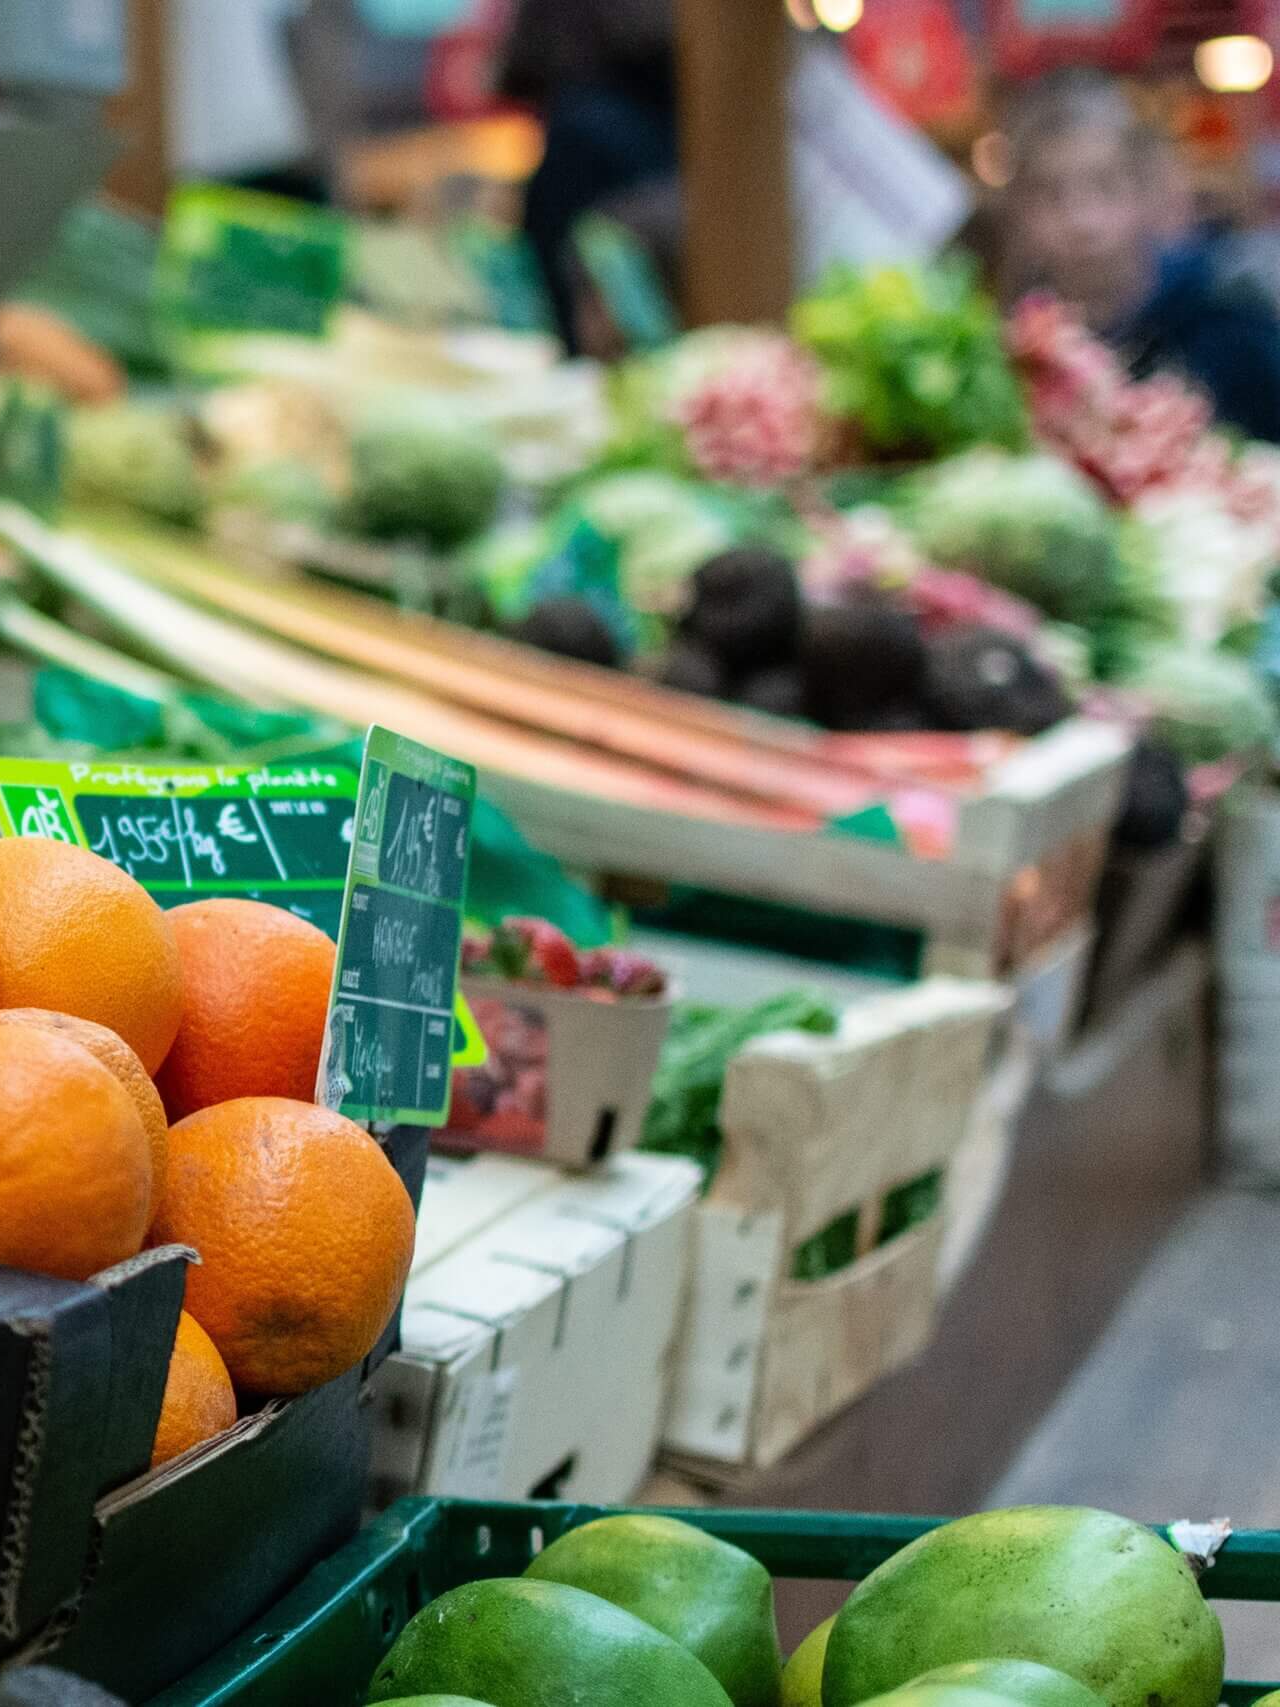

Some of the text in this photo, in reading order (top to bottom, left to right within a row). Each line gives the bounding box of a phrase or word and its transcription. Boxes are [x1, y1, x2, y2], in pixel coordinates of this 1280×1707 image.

[215, 765, 239, 787] la
[246, 766, 337, 794] planète
[21, 806, 69, 844] AB
[217, 804, 258, 842] €
[361, 787, 379, 840] AB
